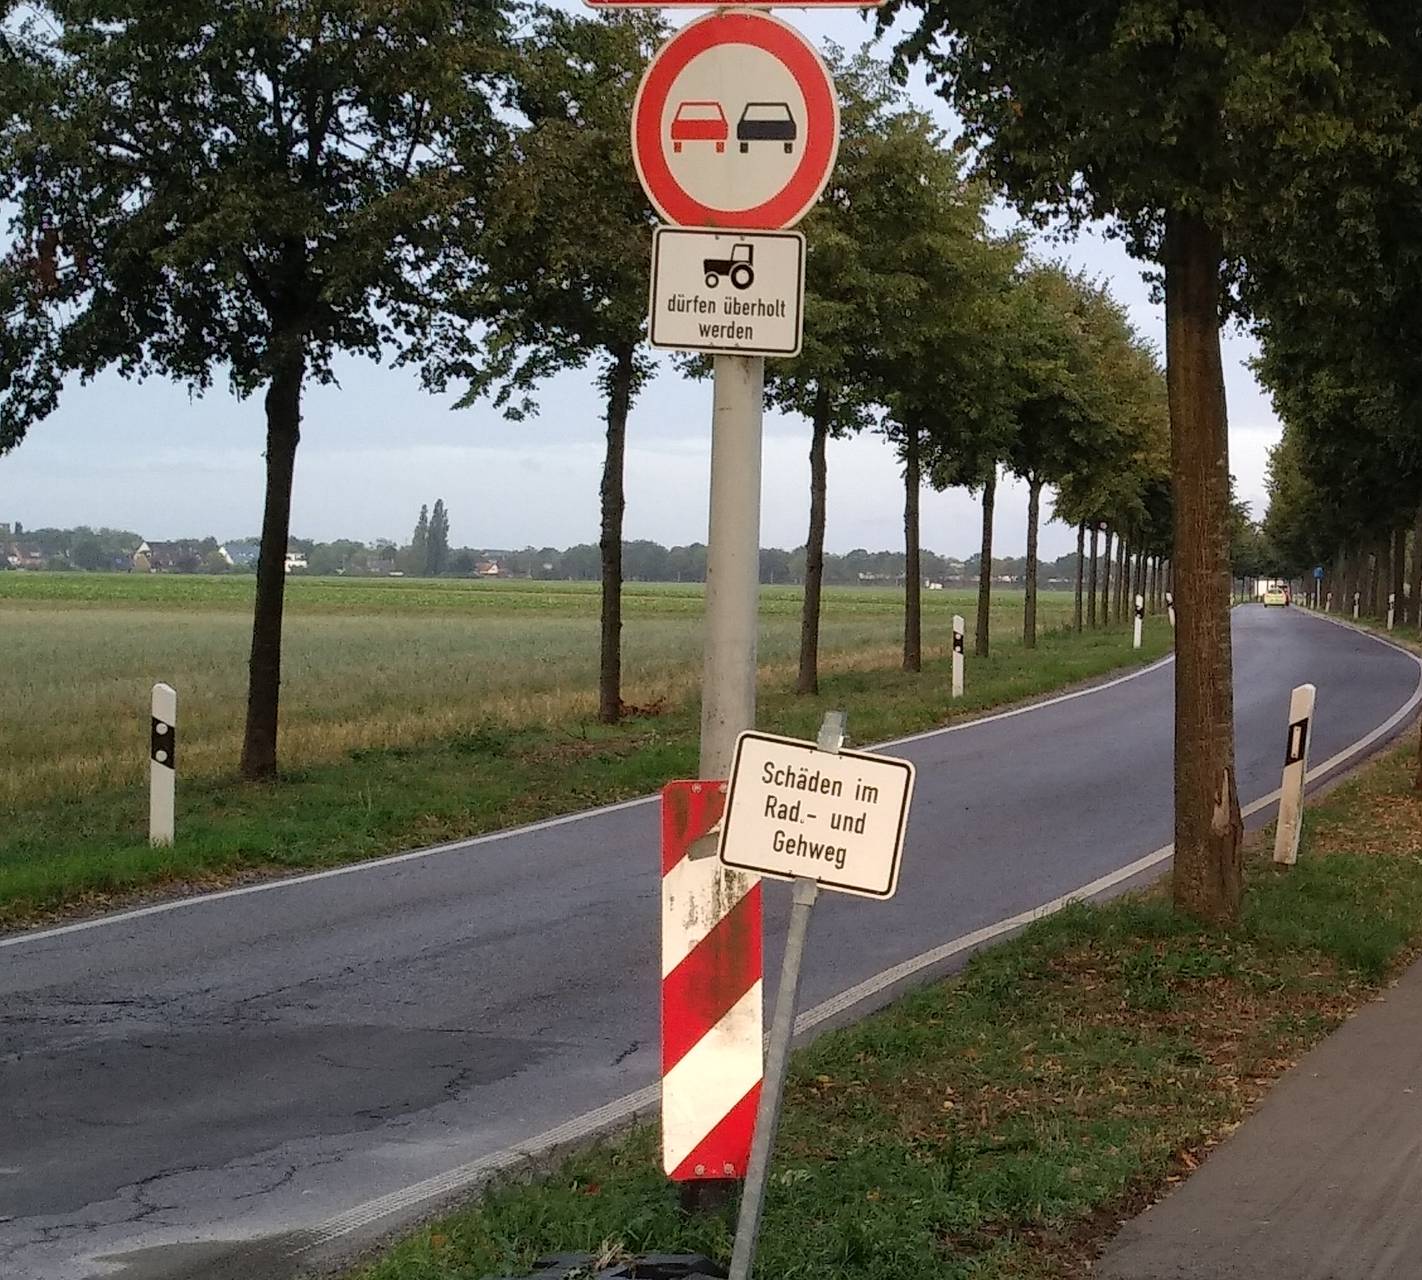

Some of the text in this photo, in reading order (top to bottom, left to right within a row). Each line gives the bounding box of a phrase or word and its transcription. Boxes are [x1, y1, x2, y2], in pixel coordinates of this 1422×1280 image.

[667, 293, 786, 318] dürfen überholt
[698, 321, 753, 340] werden
[761, 761, 879, 804] Schäden im
[830, 812, 867, 835] und
[772, 830, 847, 870] Gehweg
